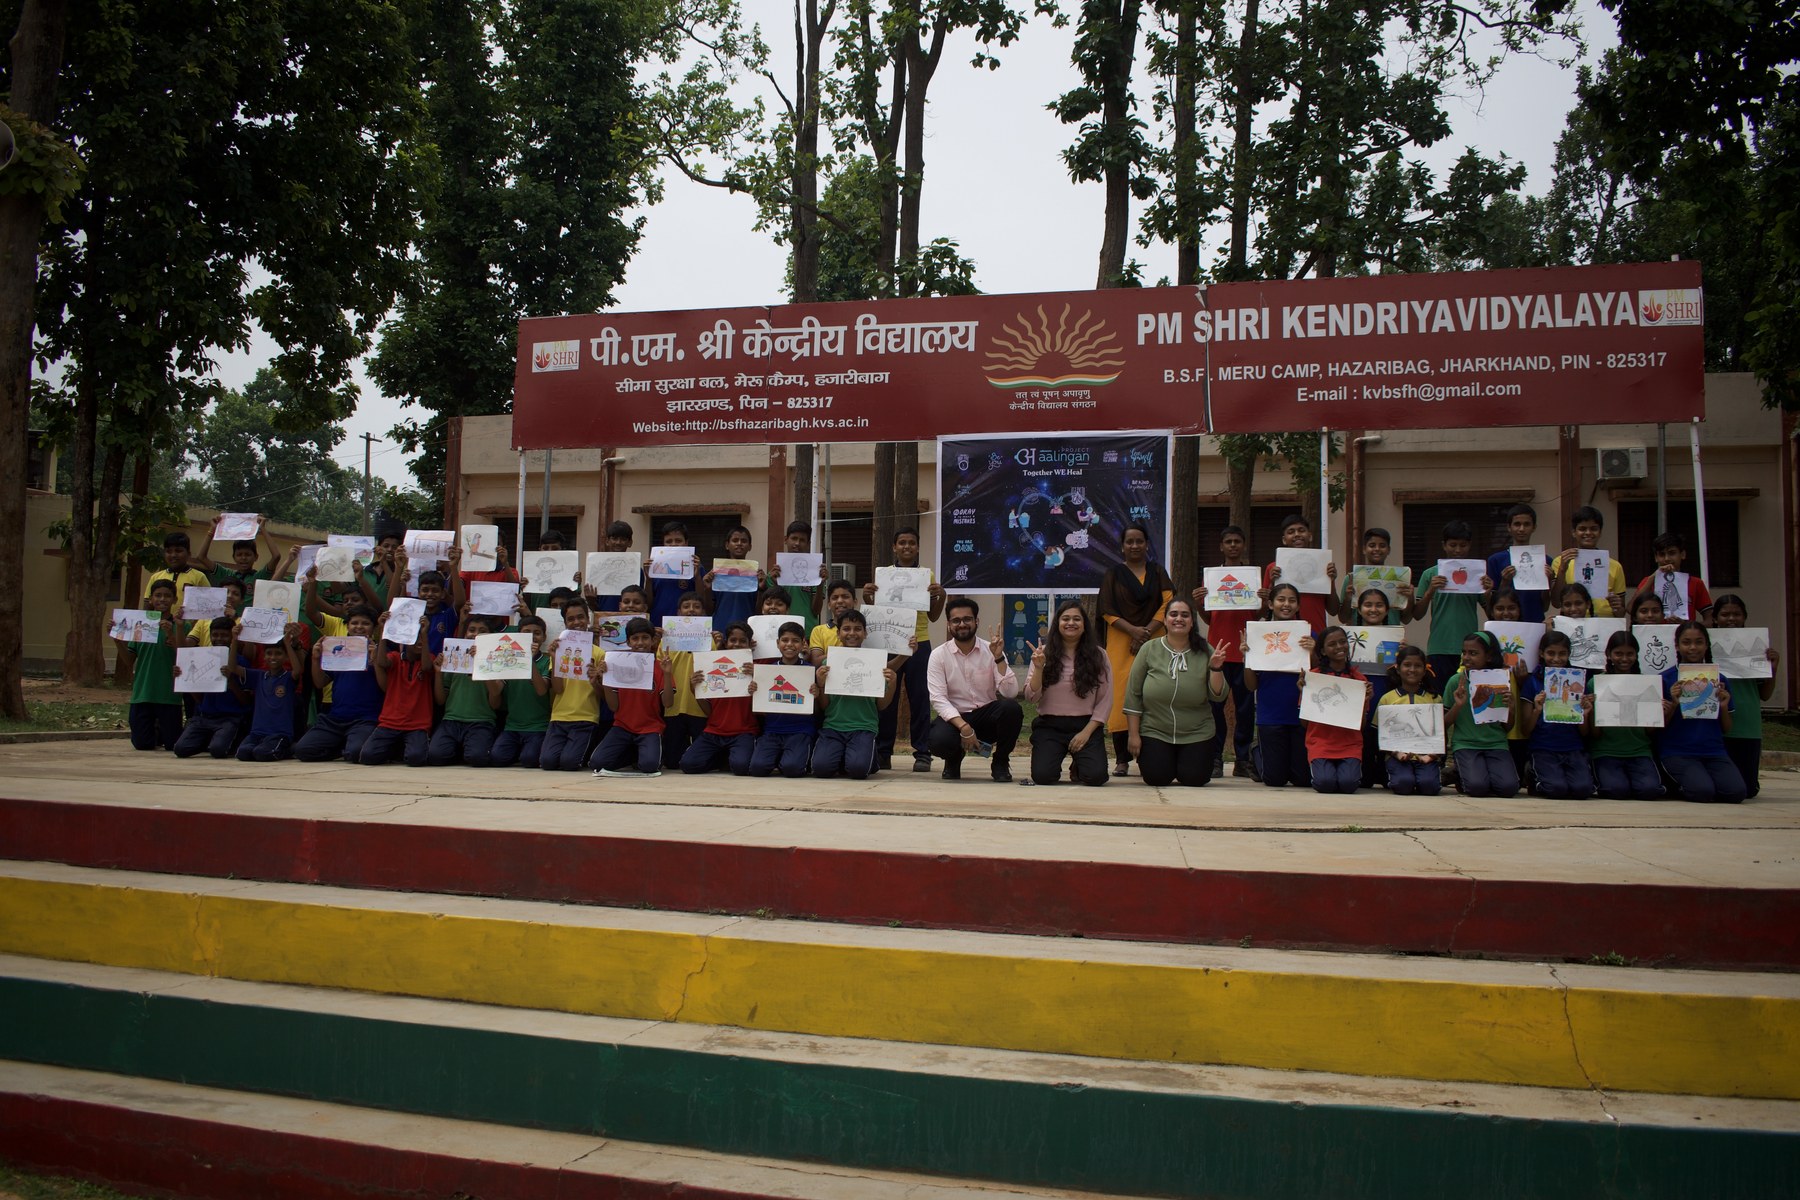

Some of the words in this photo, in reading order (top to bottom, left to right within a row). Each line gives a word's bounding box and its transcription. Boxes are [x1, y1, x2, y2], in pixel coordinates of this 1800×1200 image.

[1667, 289, 1684, 303] PM
[1137, 312, 1183, 346] PM
[1193, 307, 1270, 344] SHRI
[1282, 291, 1637, 340] KENDRIYAVIDYALAYA
[1666, 302, 1699, 319] SHRI
[590, 326, 685, 367] पी.एम.
[696, 319, 736, 361] श्री
[742, 315, 848, 362] केन्द्रीय
[855, 313, 980, 356] विद्यालय
[552, 350, 579, 366] SHRI
[1218, 365, 1266, 382] MERU
[1271, 362, 1323, 380] CAMP,
[1328, 358, 1435, 378] HAZARIBAG,
[1440, 355, 1556, 373] JHARKHAND,
[1561, 354, 1591, 370] PIN
[1606, 352, 1667, 369] 825317
[615, 378, 651, 393] सीमा
[654, 377, 695, 395] सुरक्षा
[698, 375, 729, 390] बल,
[767, 371, 809, 388] कैम्प,
[814, 369, 890, 386] हजारीबाग
[1297, 385, 1348, 402] E-mail
[1362, 381, 1522, 401] kvbsfh@gmail.com
[666, 398, 734, 413] झारखण्ड,
[738, 394, 768, 410] पिन
[786, 396, 833, 409] 825317
[1037, 400, 1069, 410] विद्यालय
[632, 416, 869, 434] Website:http://bsfhazaribagh.kvs.ac.in
[1038, 449, 1090, 467] aalingan
[1023, 469, 1053, 477] Together
[1067, 468, 1083, 476] Heal
